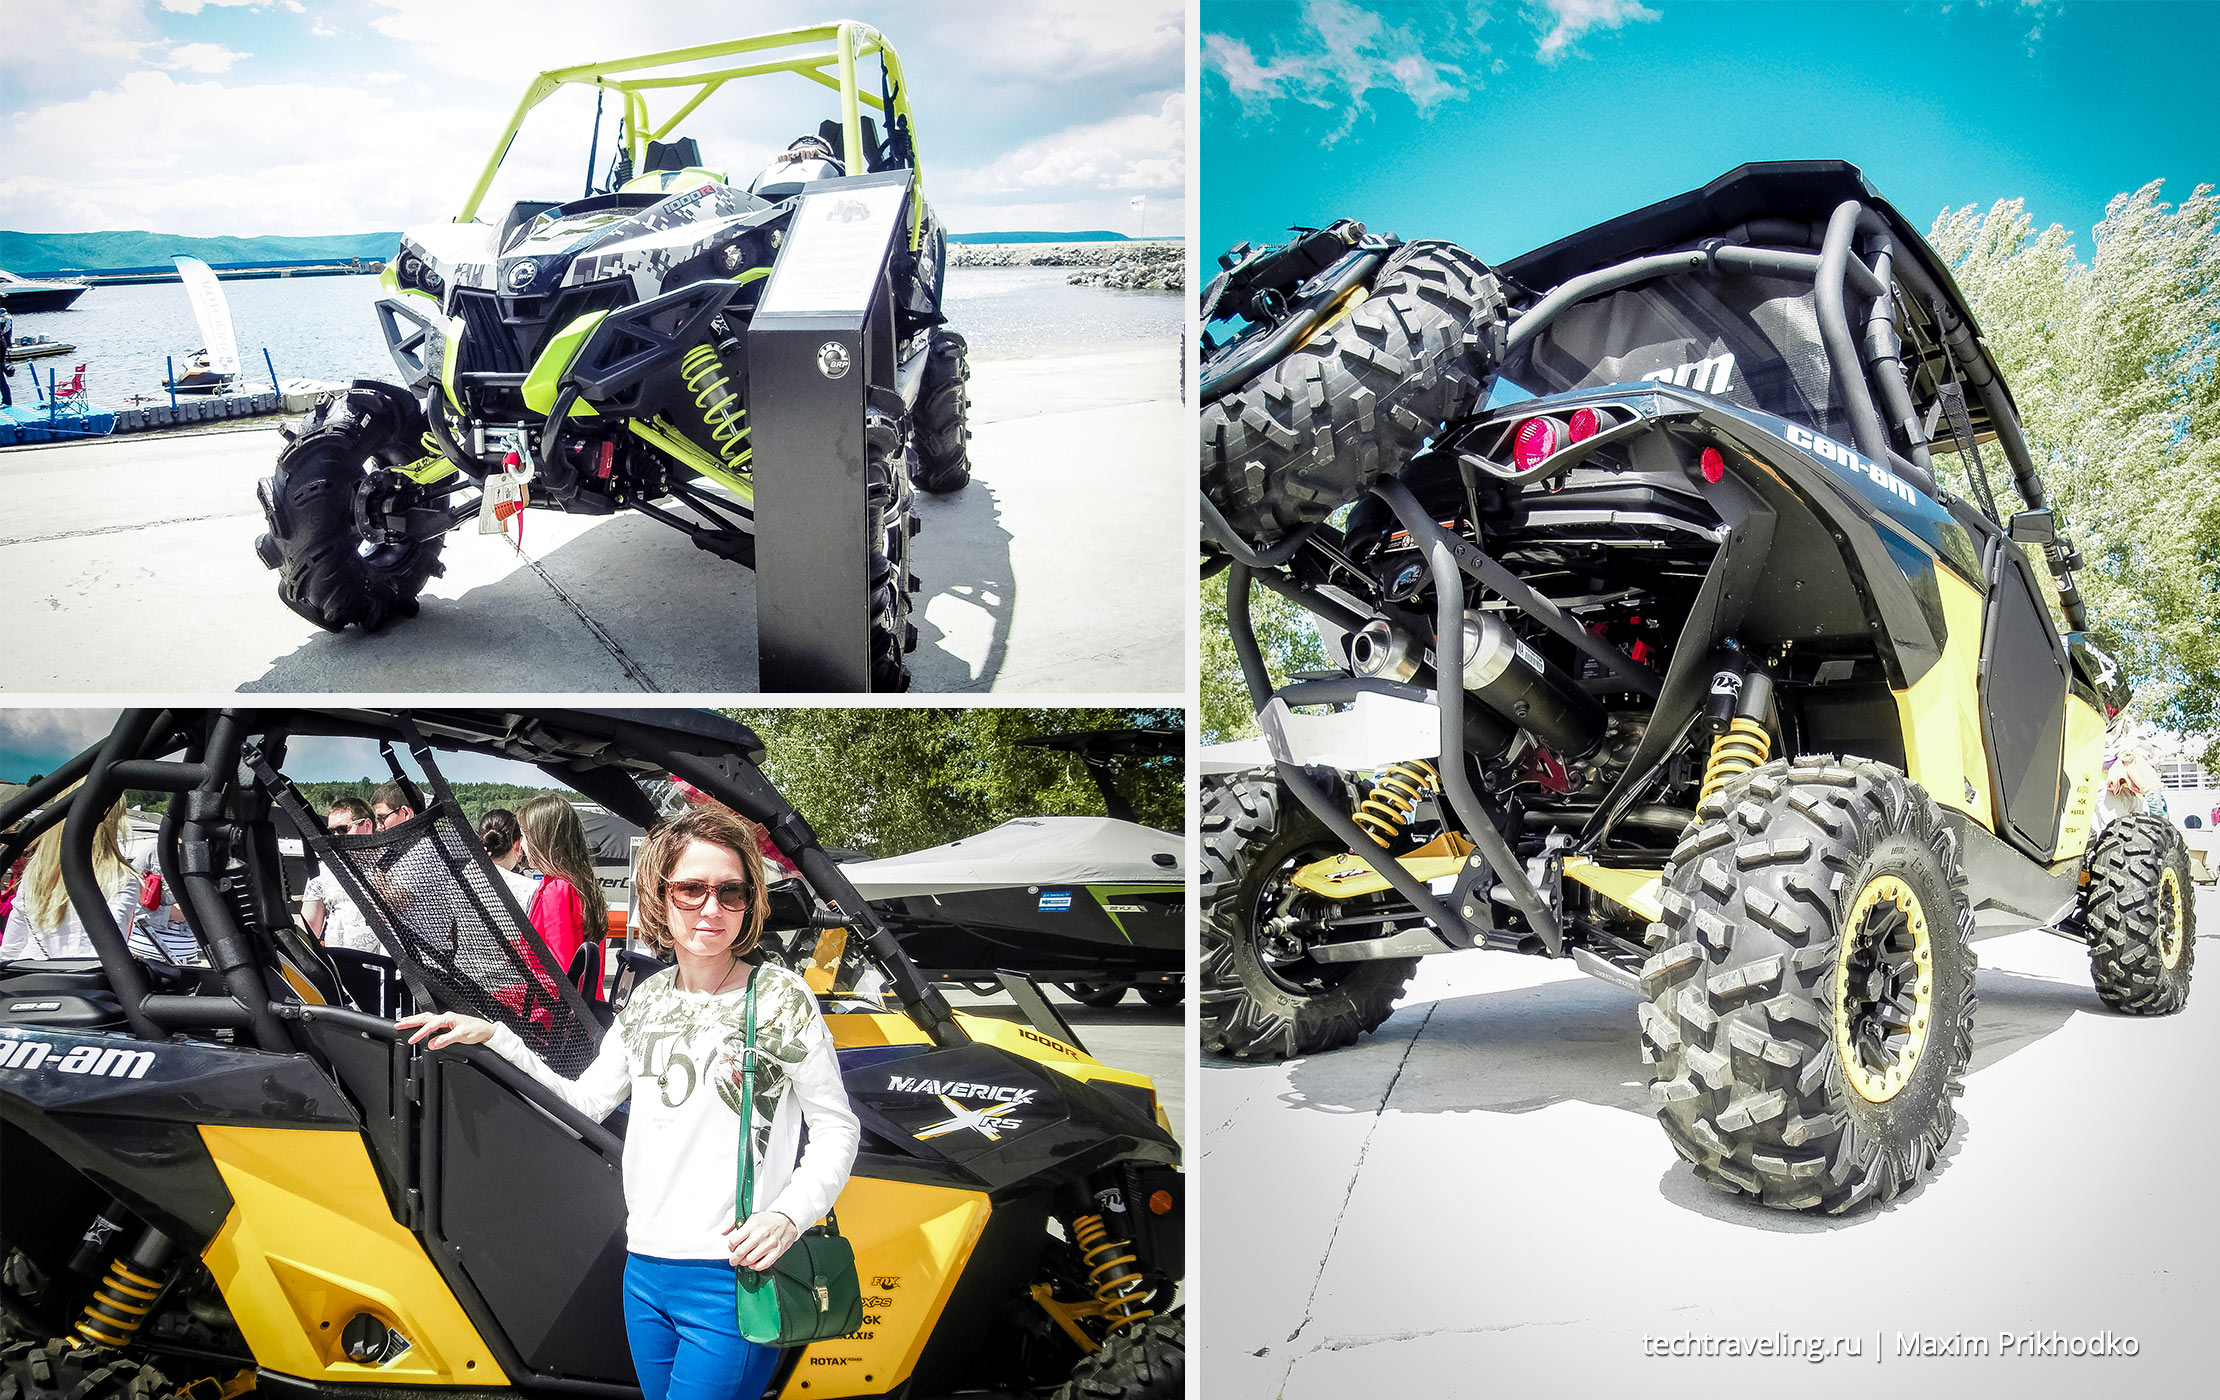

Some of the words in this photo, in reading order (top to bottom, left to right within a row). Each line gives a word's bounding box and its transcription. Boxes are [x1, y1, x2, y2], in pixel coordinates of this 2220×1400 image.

[663, 185, 715, 215] 1000R
[1785, 423, 1917, 507] can-am
[0, 1039, 156, 1079] an-am
[1018, 1027, 1080, 1062] 1000R
[886, 1075, 1038, 1104] MAVERICK
[871, 1276, 901, 1290] FOX
[862, 1315, 882, 1325] GK
[845, 1331, 875, 1340] XXIS
[810, 1357, 848, 1366] ROTAX
